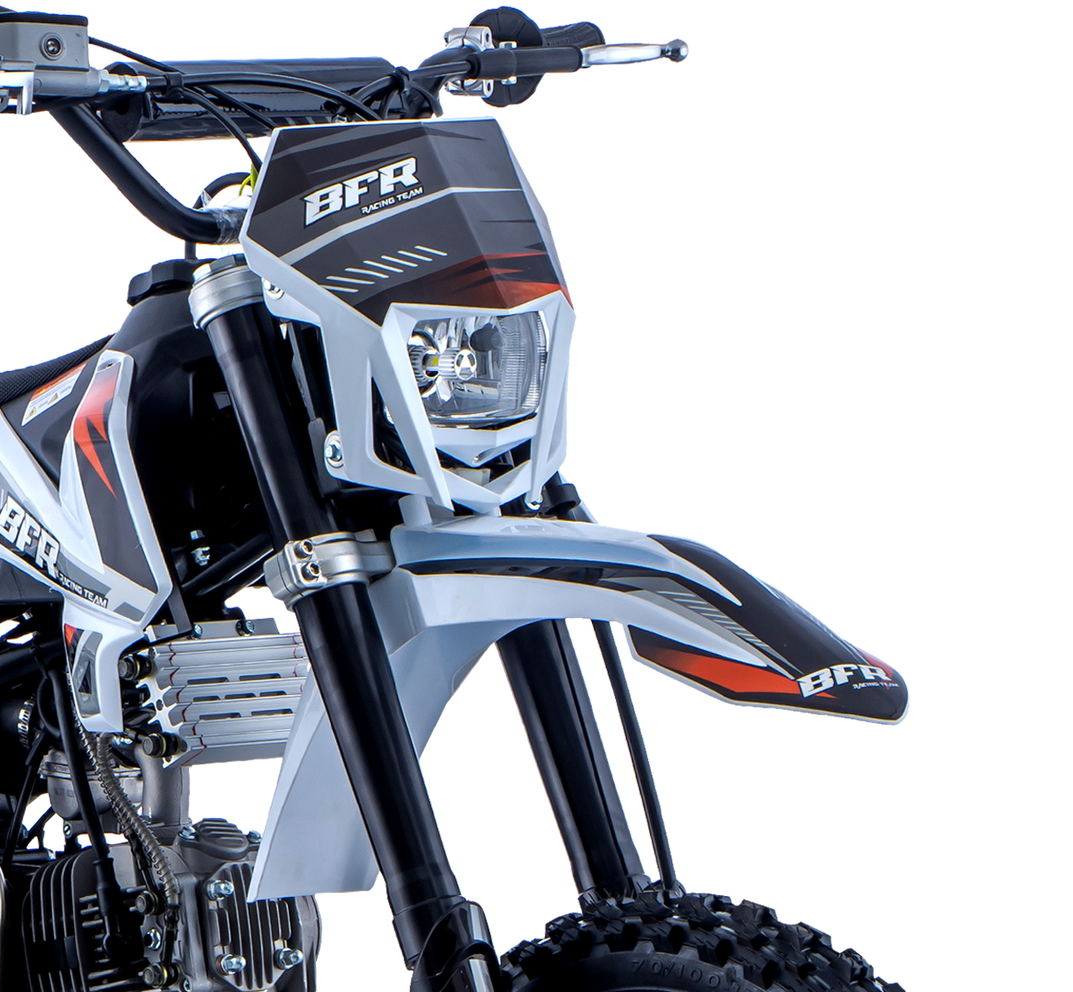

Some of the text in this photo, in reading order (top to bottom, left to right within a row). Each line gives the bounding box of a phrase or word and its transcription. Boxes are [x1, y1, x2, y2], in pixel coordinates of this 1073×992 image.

[303, 156, 419, 227] BFR
[360, 186, 424, 214] RACING TEAM
[83, 588, 108, 609] TEAM
[795, 663, 893, 699] BFR
